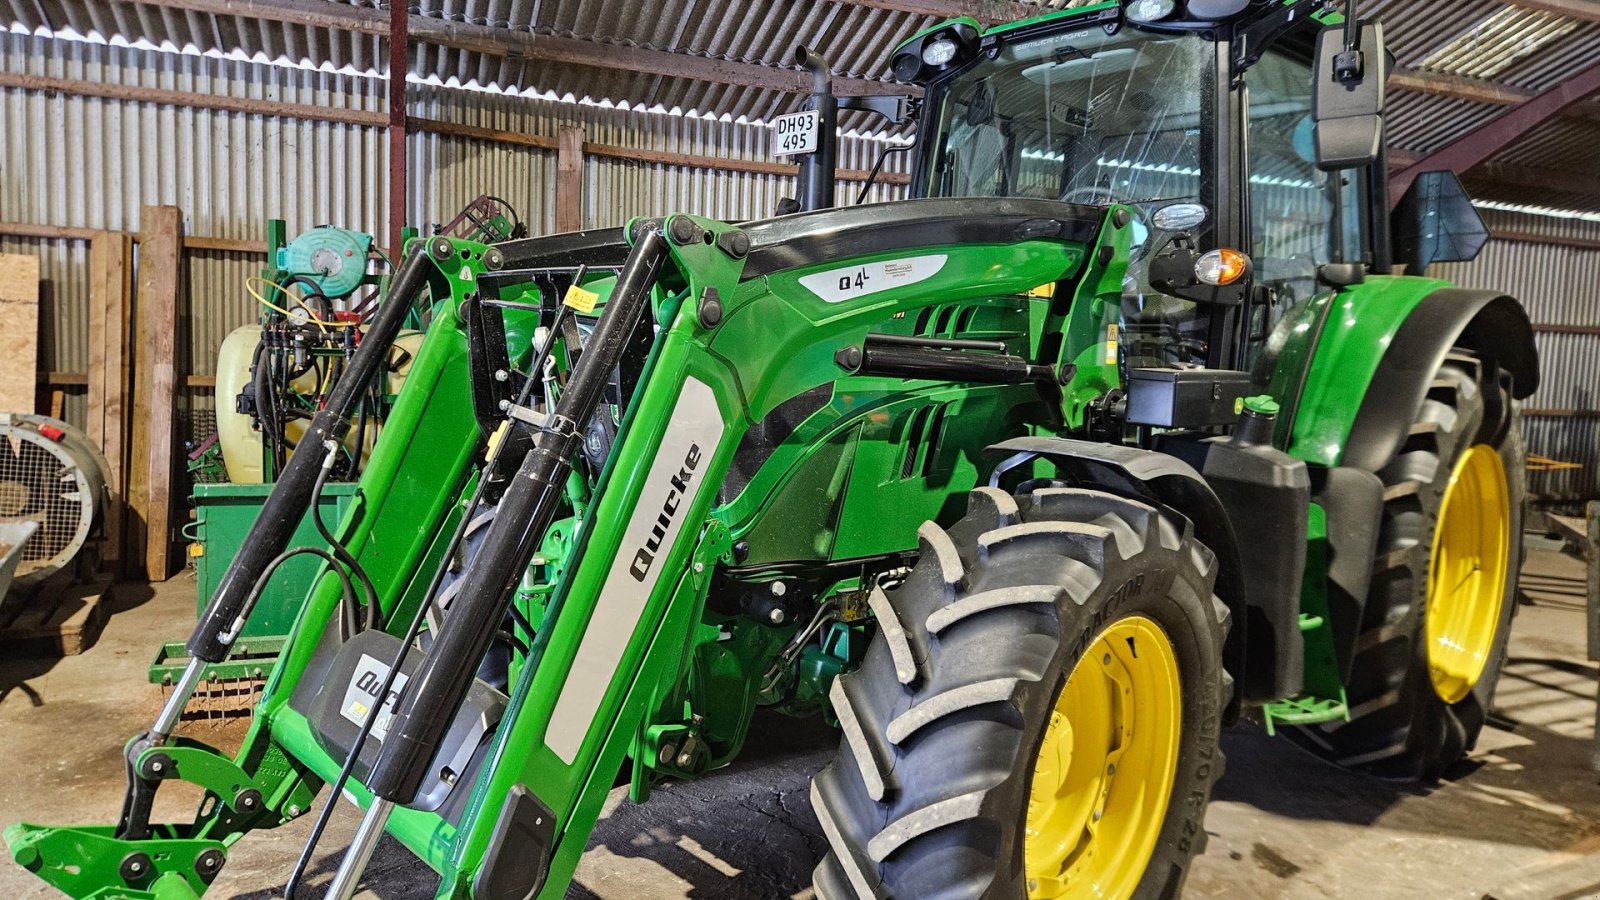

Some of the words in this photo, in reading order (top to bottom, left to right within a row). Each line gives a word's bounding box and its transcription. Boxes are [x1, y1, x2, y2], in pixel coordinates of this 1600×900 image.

[1060, 30, 1088, 41] AGRO
[778, 115, 813, 134] DH93
[783, 133, 806, 150] 495
[629, 443, 702, 583] Quicke
